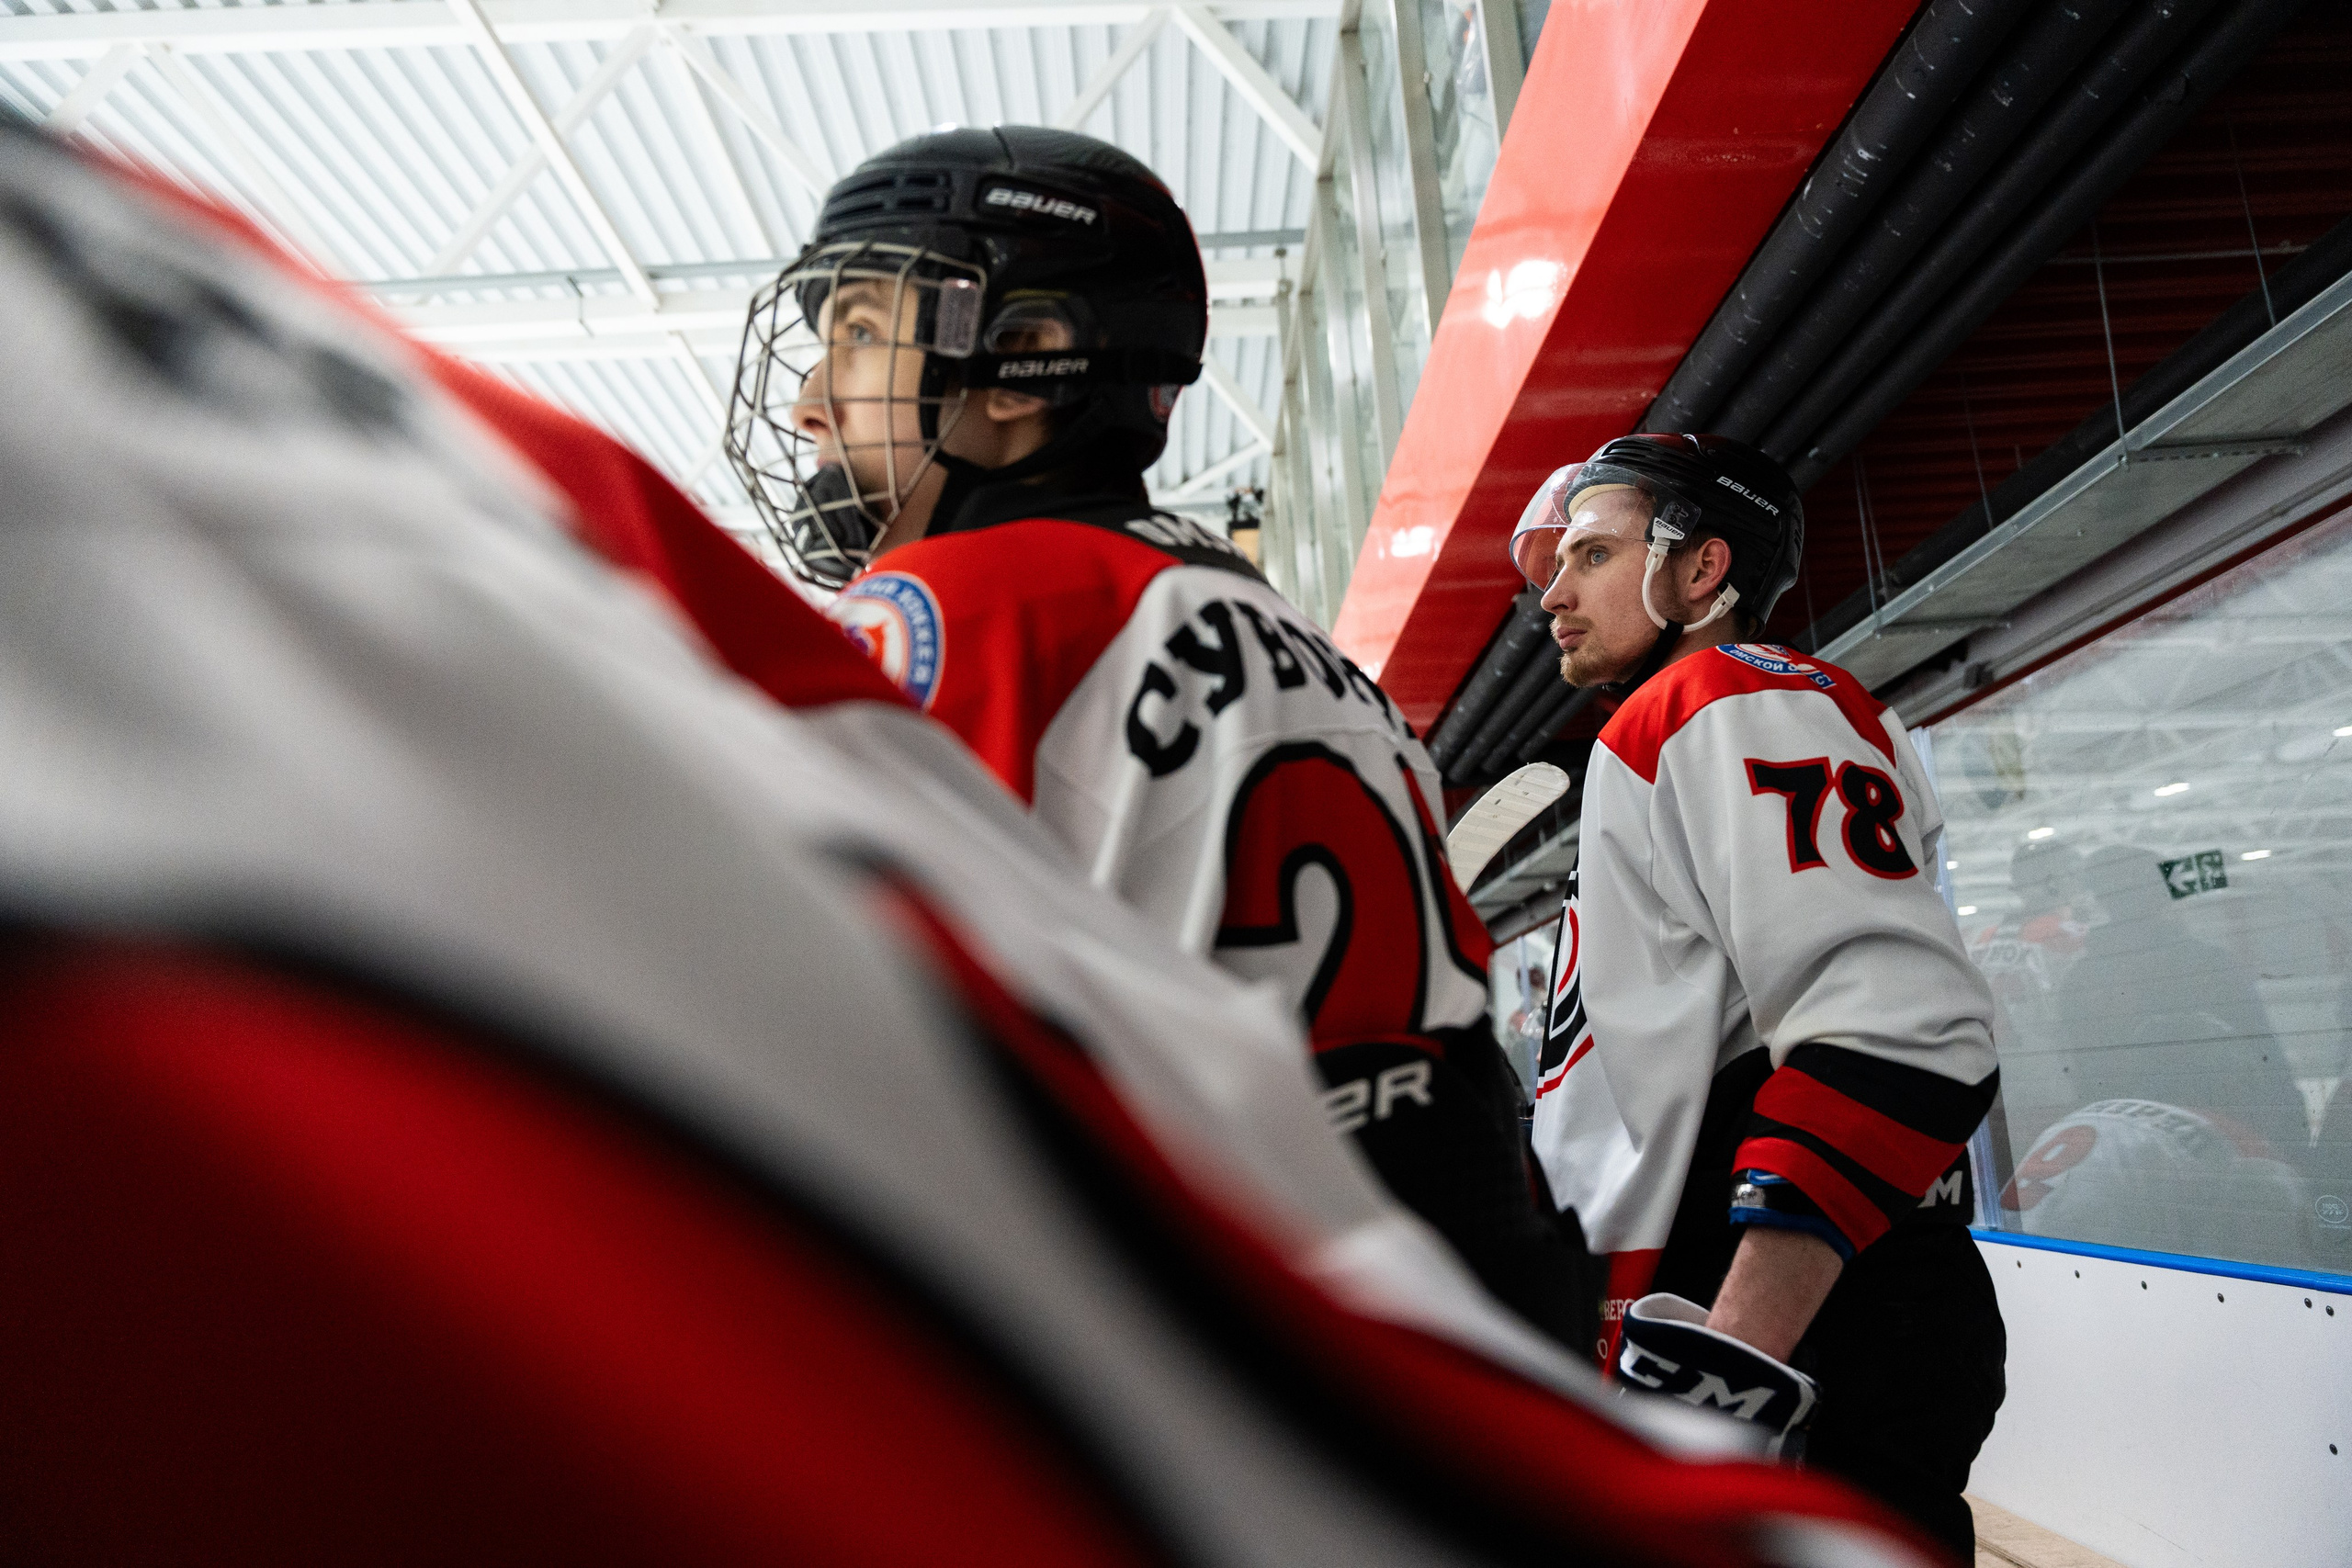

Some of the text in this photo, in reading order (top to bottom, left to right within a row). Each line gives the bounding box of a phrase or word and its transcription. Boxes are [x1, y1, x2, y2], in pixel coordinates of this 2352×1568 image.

[985, 186, 1098, 226] BAUER
[998, 357, 1090, 379] BAUER
[1716, 475, 1780, 516] BAUER
[1655, 519, 1684, 537] BAUER
[1743, 756, 1919, 880] 78
